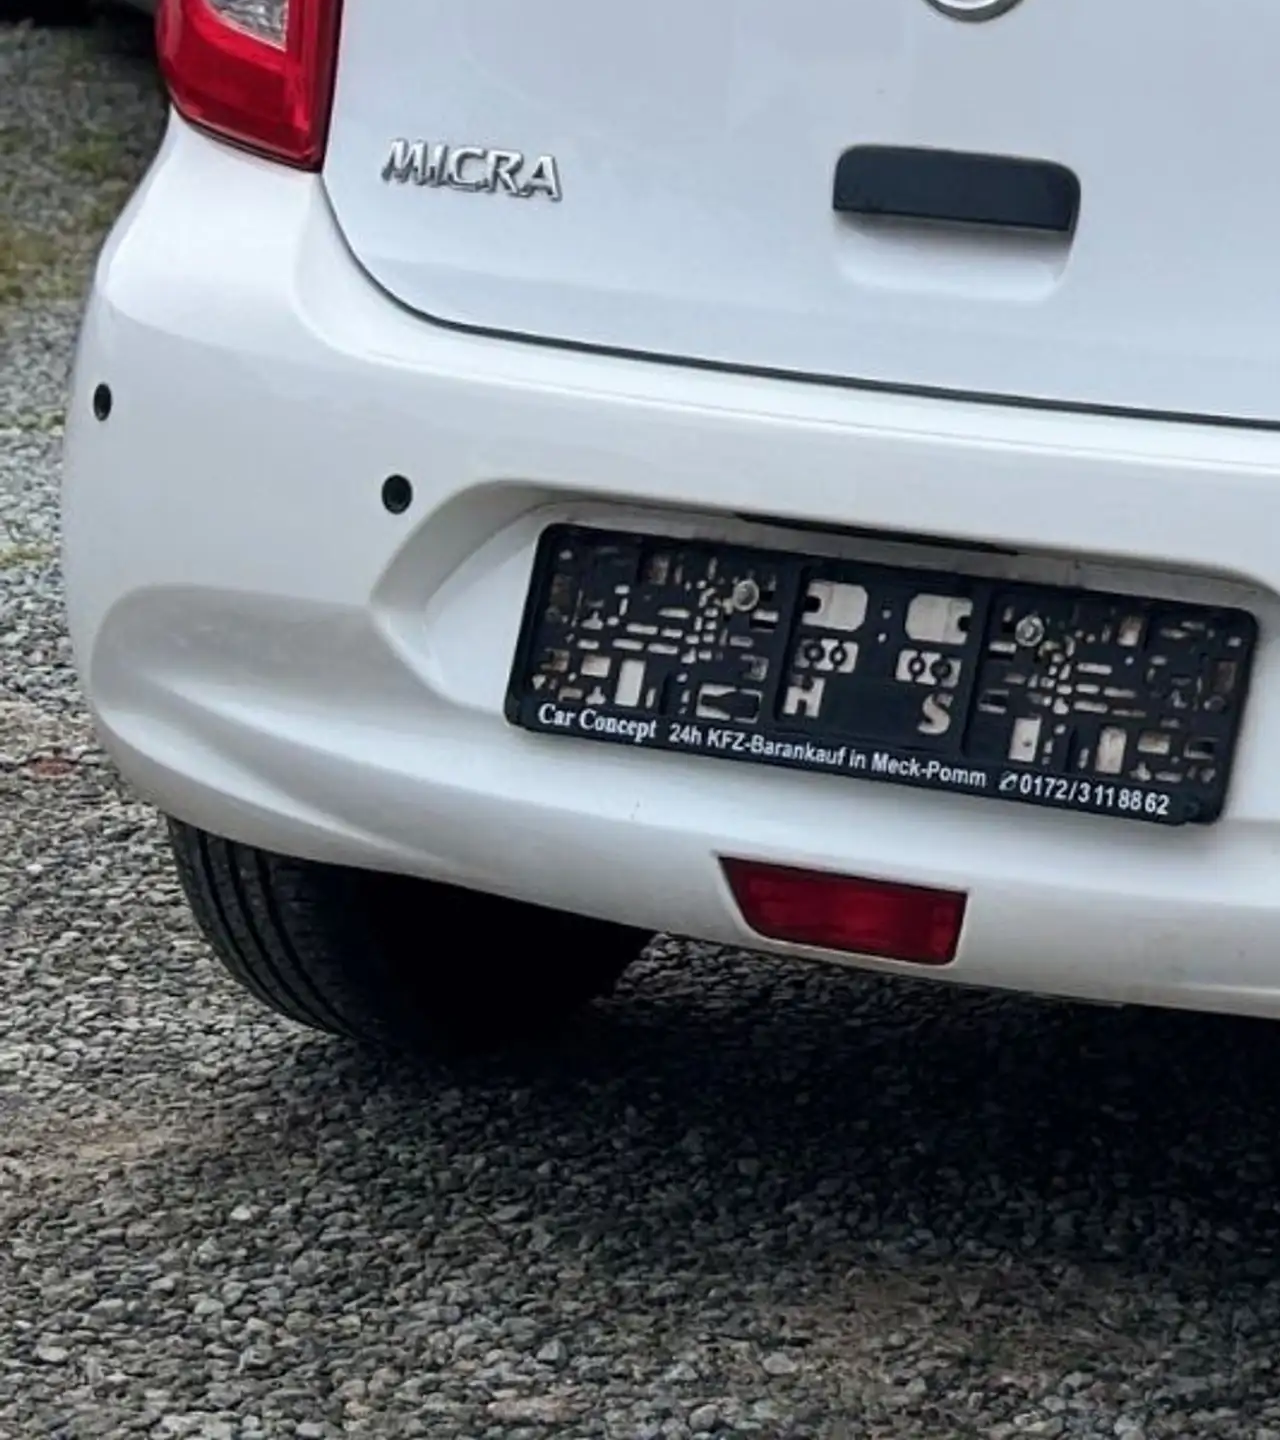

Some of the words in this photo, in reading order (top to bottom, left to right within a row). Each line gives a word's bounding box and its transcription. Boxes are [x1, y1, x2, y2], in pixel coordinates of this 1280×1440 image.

[382, 137, 562, 202] MICRA
[538, 702, 575, 728] Car
[578, 707, 658, 744] Concept
[668, 722, 702, 745] 24h
[707, 728, 847, 769] KFZ-Barankauf
[848, 747, 866, 771] in
[870, 752, 987, 789] Meck-Pomm
